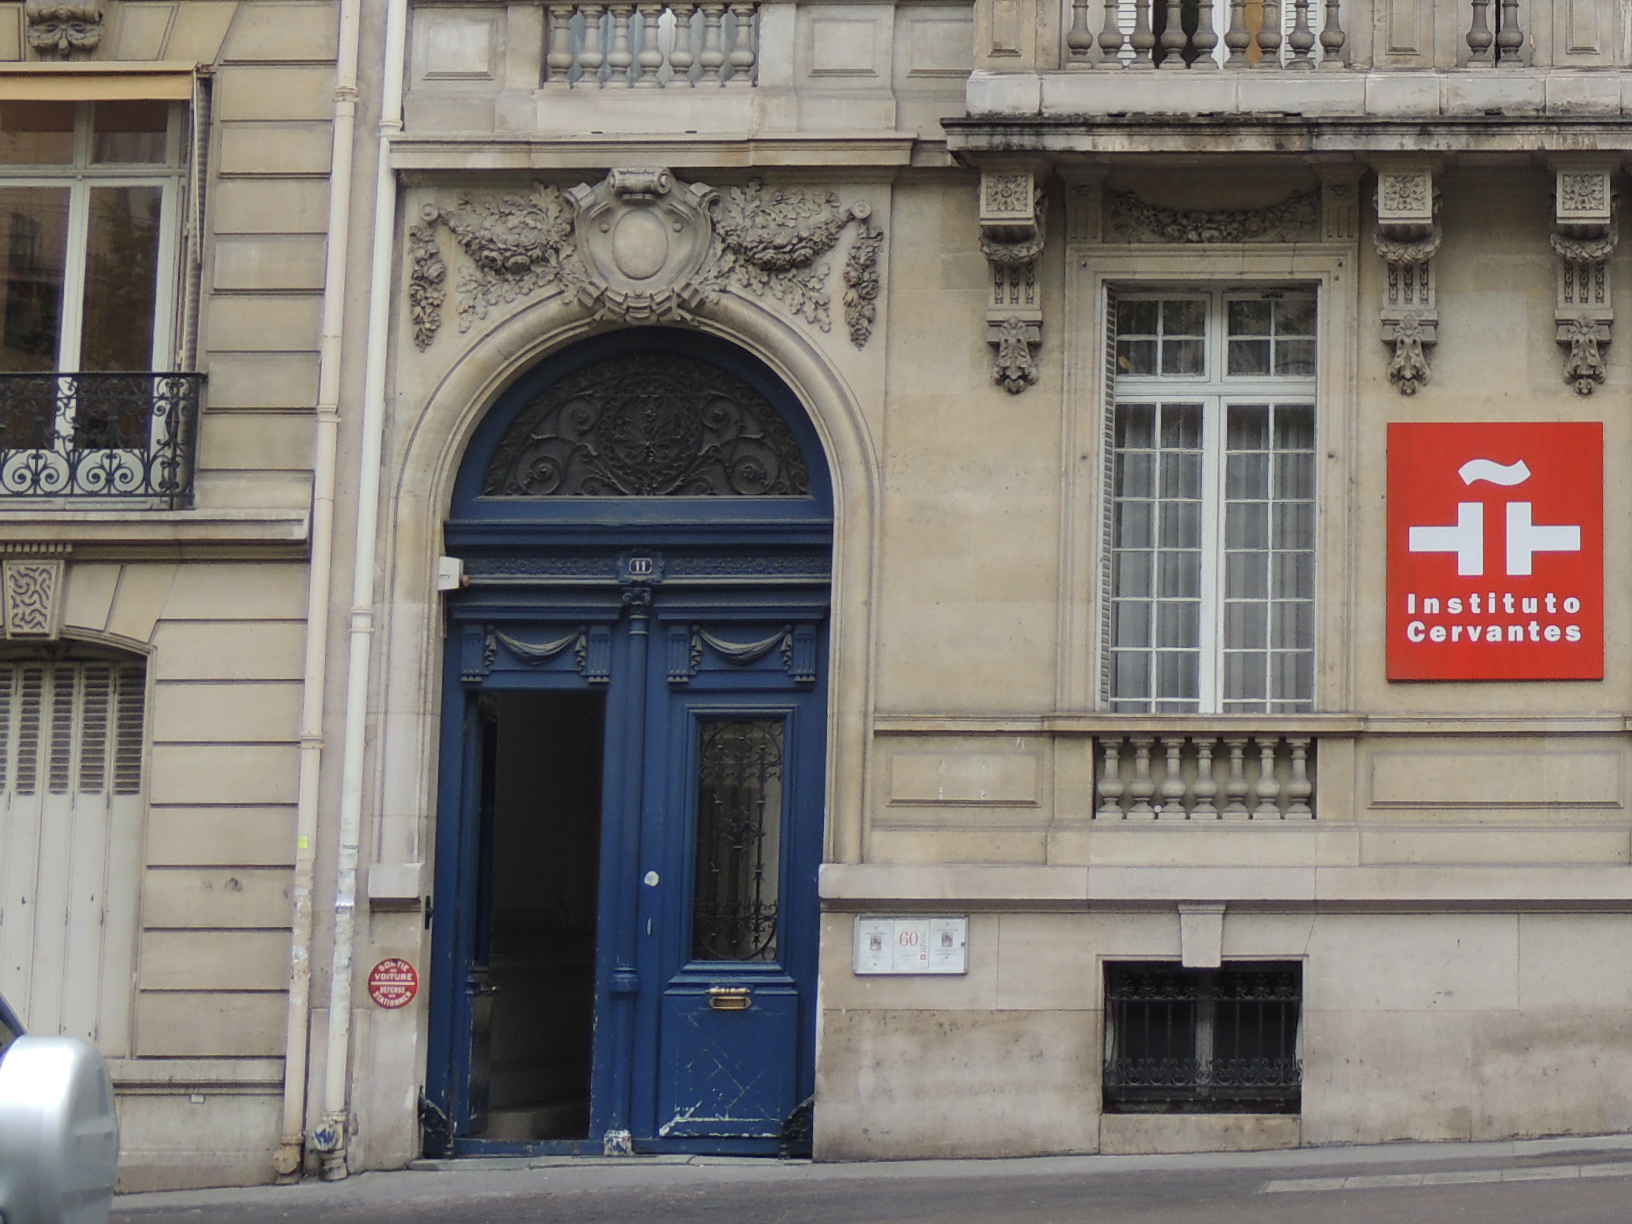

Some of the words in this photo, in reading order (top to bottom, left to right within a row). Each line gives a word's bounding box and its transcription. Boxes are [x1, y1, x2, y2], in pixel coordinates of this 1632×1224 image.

[635, 560, 646, 572] 11
[1407, 592, 1581, 614] Instituto
[1407, 620, 1582, 643] Cervantes
[899, 931, 919, 947] 60
[374, 973, 413, 981] VOITURE
